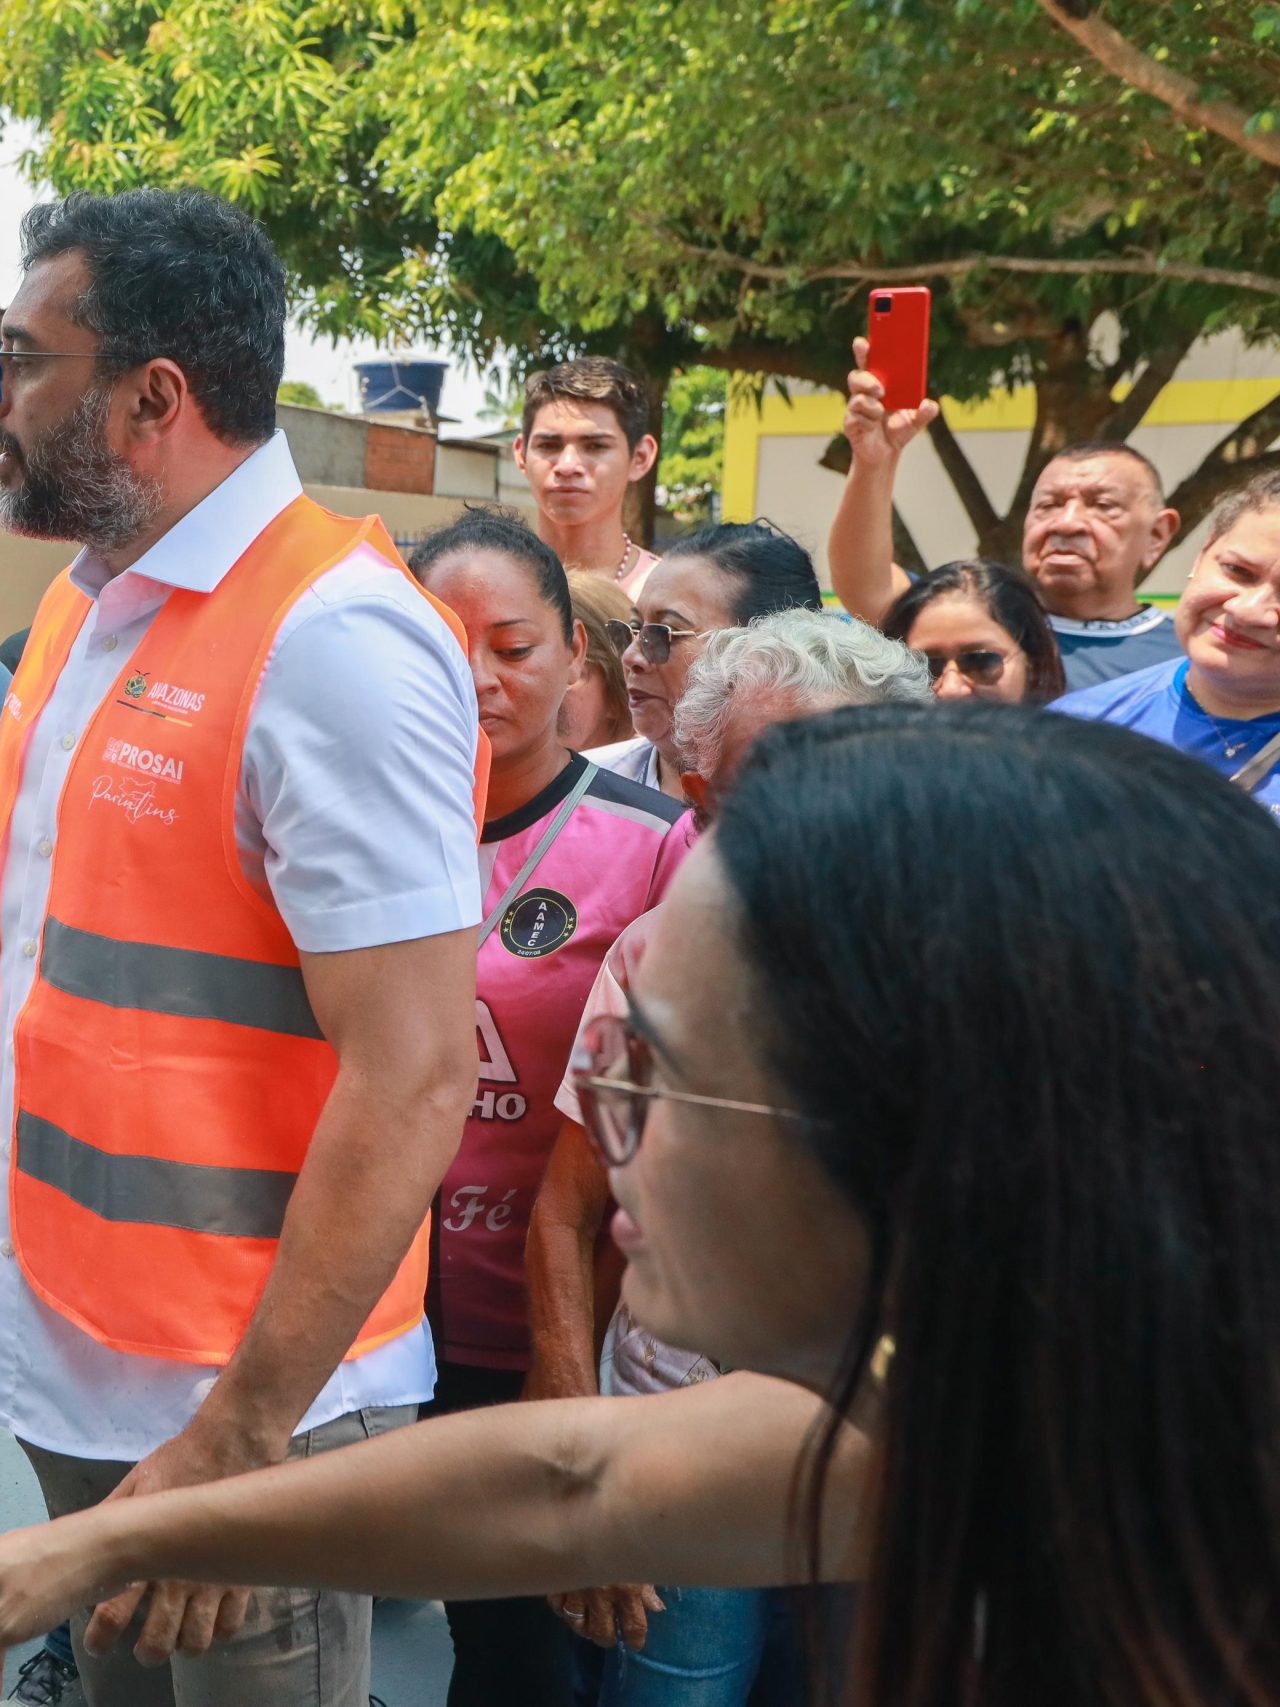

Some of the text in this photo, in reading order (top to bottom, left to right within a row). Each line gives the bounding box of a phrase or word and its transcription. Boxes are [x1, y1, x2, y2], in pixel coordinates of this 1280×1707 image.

[118, 742, 184, 780] PROSAI
[88, 775, 180, 825] Parintins
[443, 1185, 517, 1232] Fé
